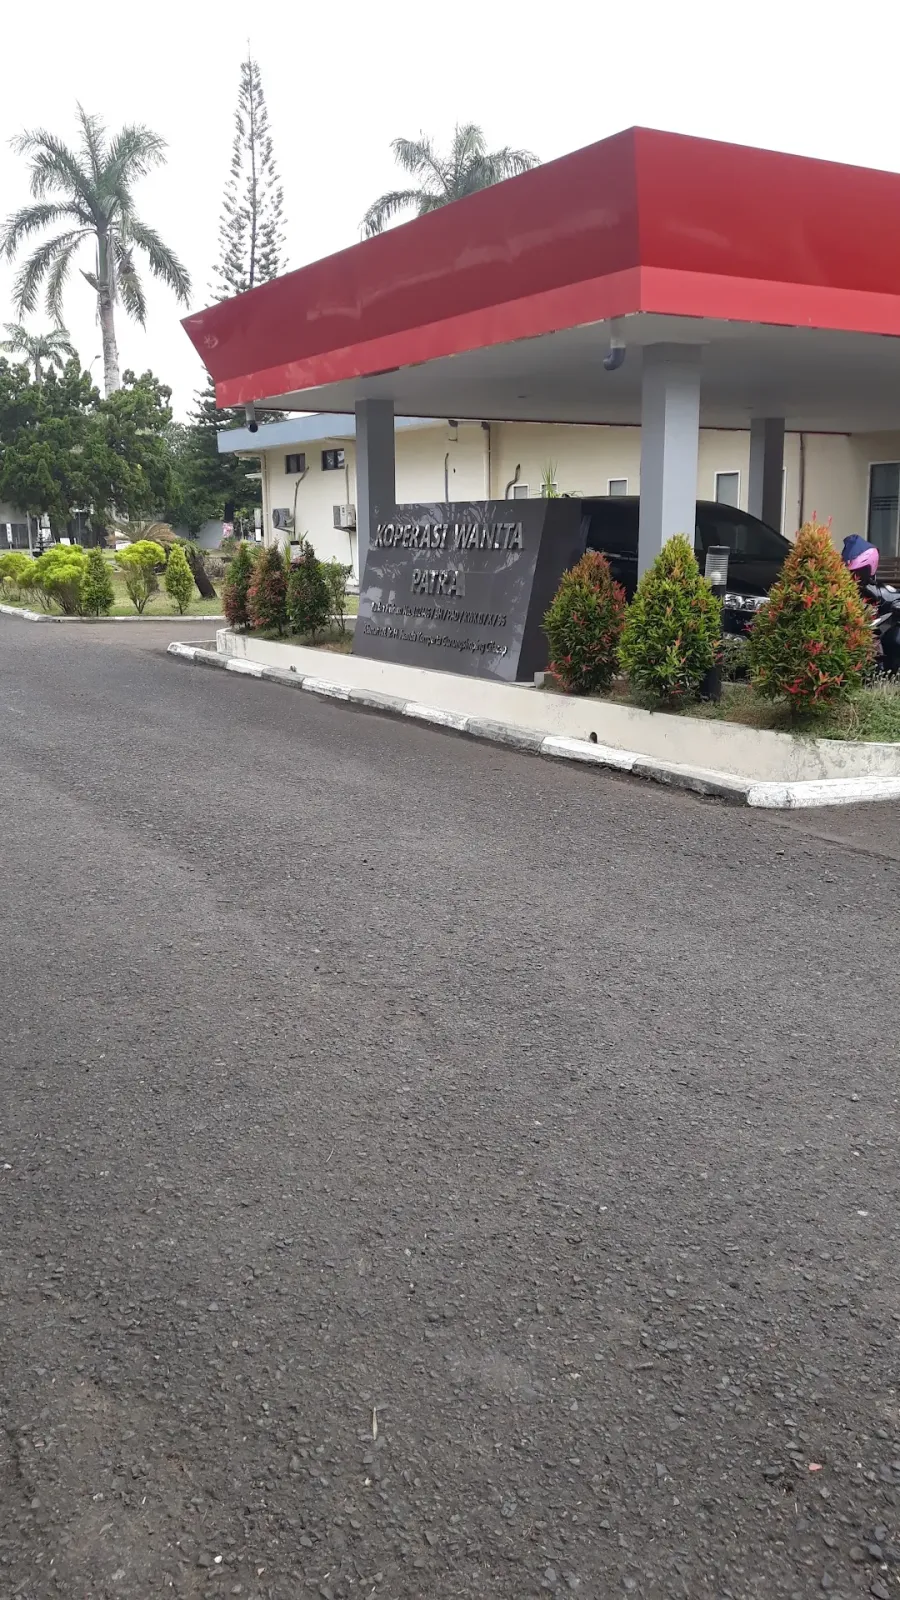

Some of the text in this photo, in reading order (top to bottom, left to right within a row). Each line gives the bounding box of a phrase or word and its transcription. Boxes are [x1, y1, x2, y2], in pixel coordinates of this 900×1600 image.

[374, 522, 524, 550] KOPERASI WANITA
[411, 568, 466, 597] PATRA
